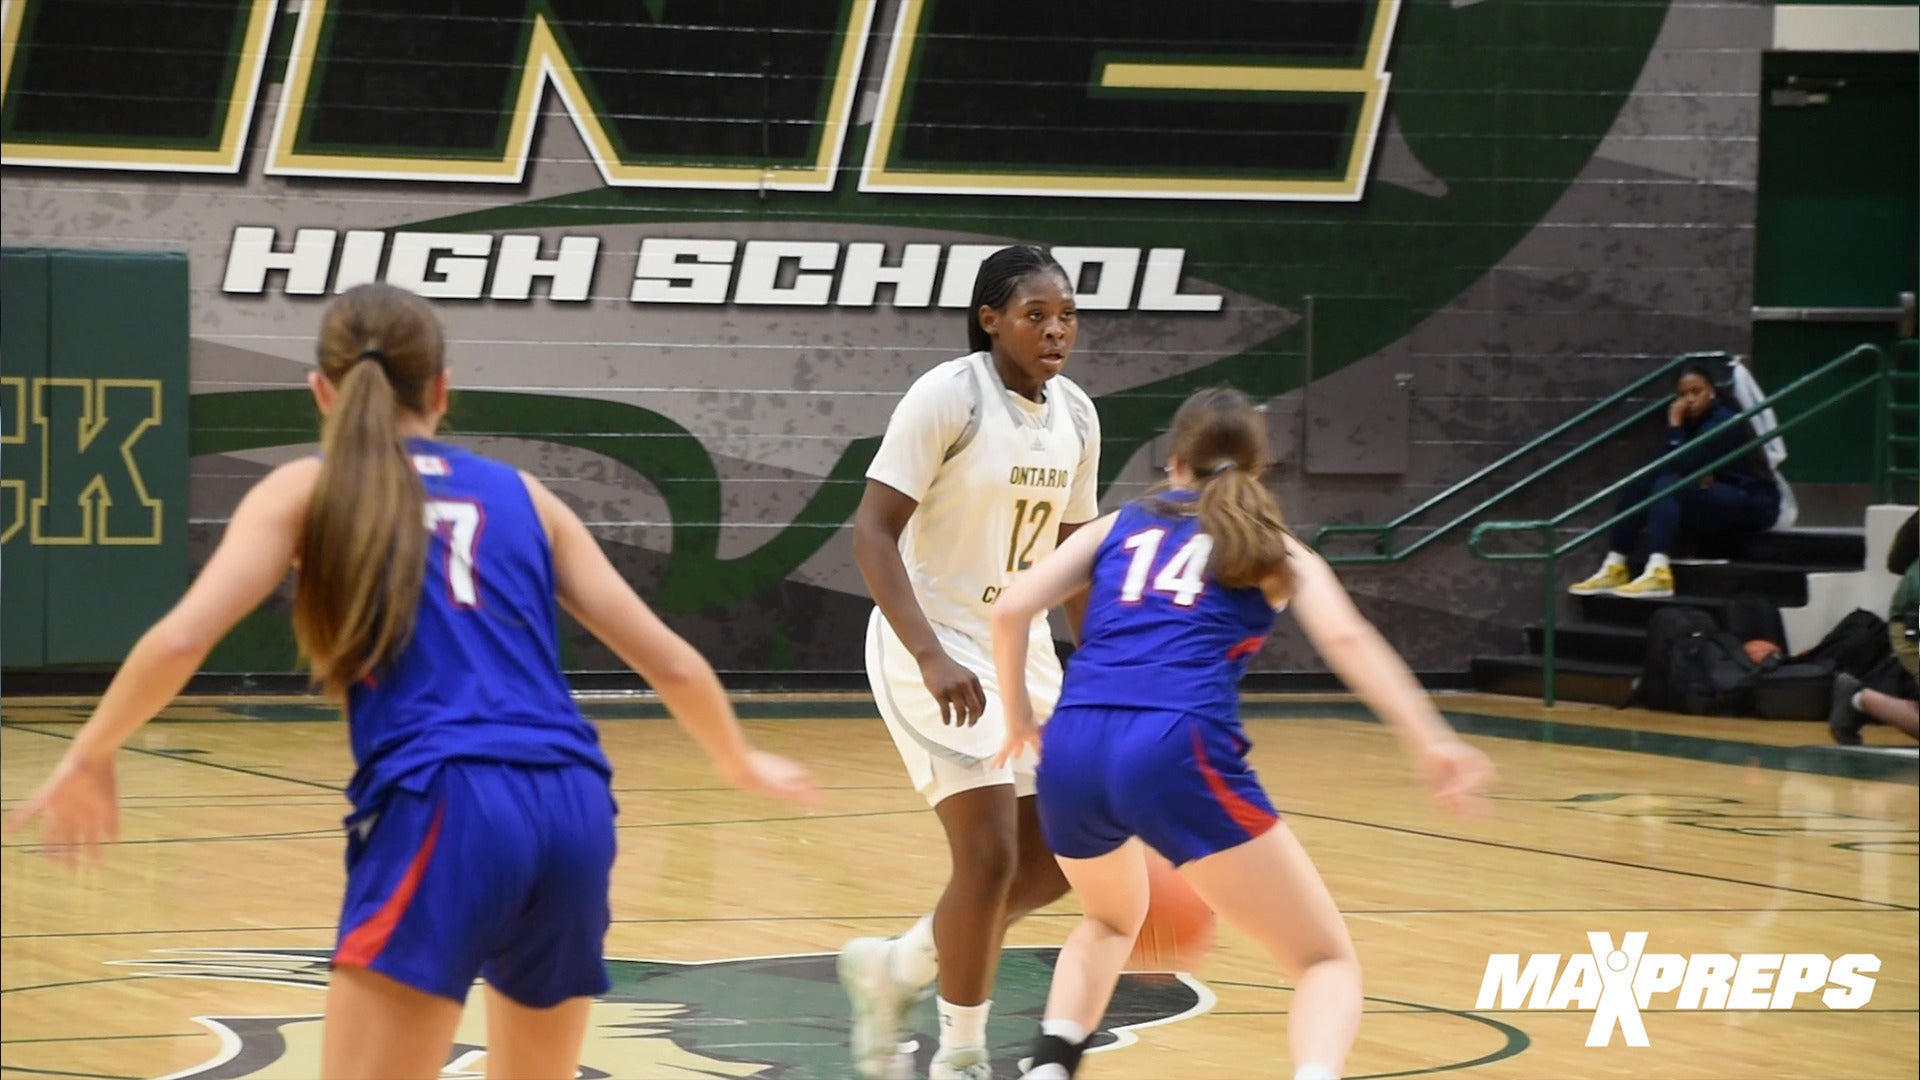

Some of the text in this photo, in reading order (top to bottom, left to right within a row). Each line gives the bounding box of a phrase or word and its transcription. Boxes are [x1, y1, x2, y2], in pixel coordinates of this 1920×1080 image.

[222, 226, 599, 302] HIGH
[1009, 465, 1069, 489] ONTARIO
[1006, 498, 1053, 573] 12
[1119, 525, 1215, 611] 14
